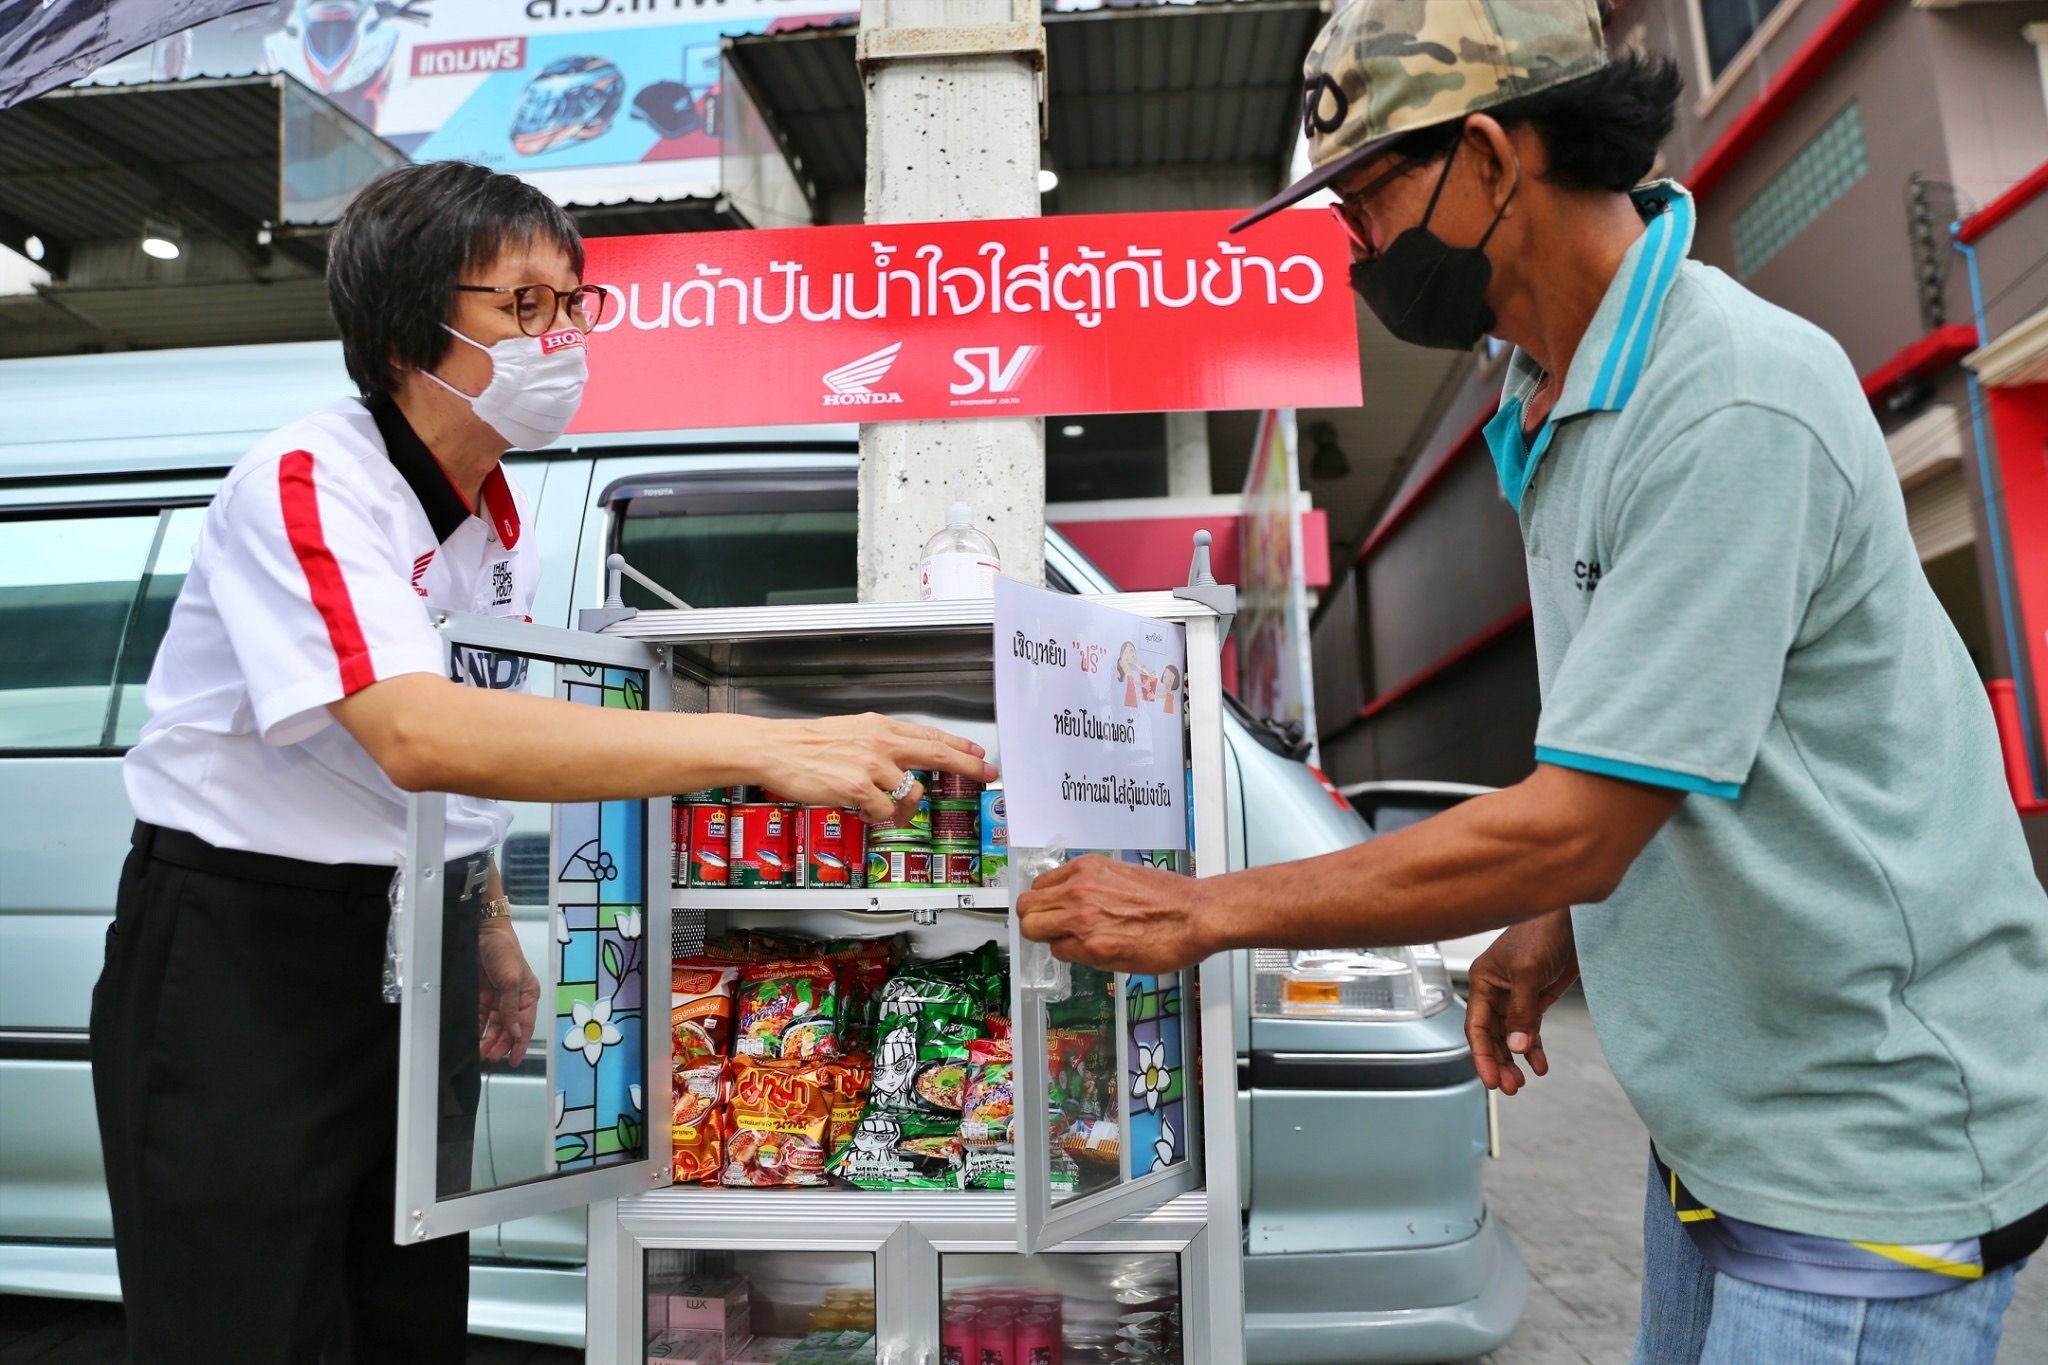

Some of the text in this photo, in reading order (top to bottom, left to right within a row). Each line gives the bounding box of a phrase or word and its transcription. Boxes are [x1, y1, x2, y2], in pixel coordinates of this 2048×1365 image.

[582, 241, 1324, 332] อนด้าปันน้ำใจใส่ตู้กับข้าว
[950, 345, 1045, 396] SV
[822, 391, 904, 406] HONDA
[642, 487, 674, 497] TOYOTA
[492, 572, 513, 586] STOPS
[495, 584, 513, 598] YOU?
[1013, 630, 1067, 668] เชิญหยิบ
[1053, 708, 1136, 745] หยิบไปแต่พอดี
[992, 827, 1007, 838] 100
[686, 1299, 708, 1310] LUX
